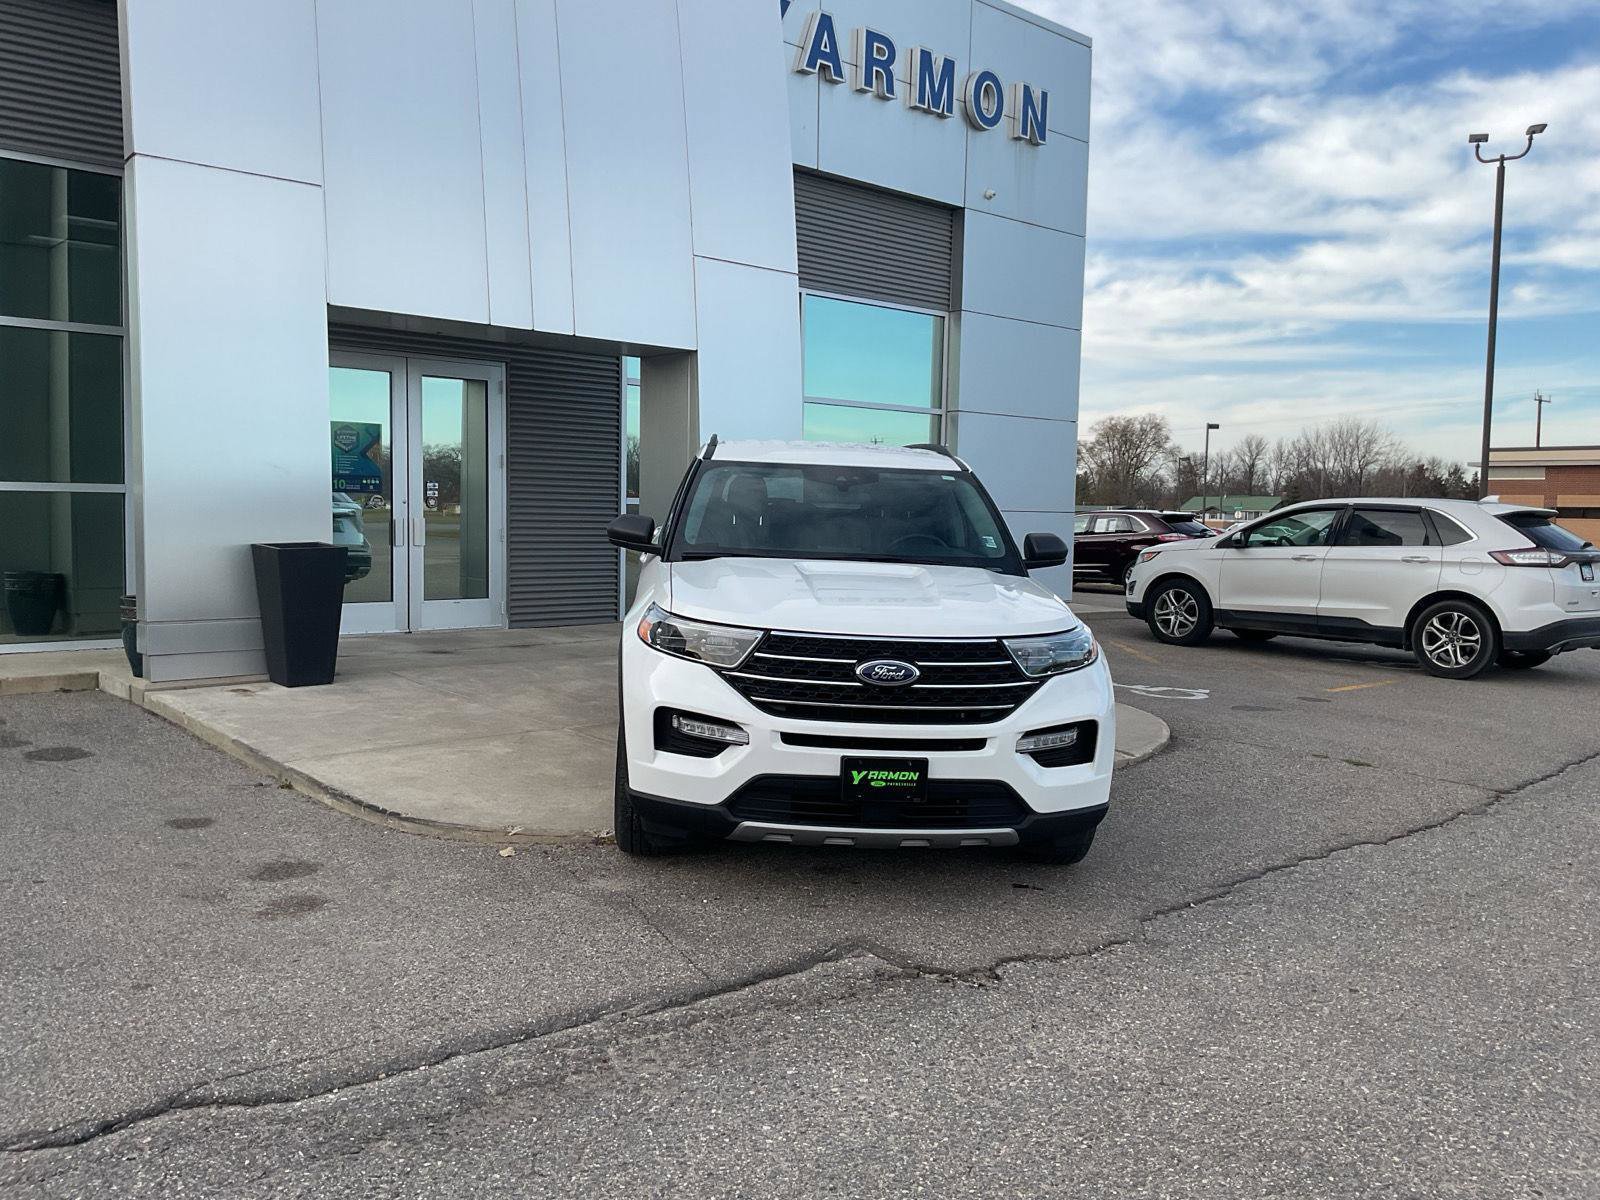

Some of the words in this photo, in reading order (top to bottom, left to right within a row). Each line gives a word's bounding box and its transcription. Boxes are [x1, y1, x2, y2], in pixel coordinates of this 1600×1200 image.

[780, 0, 1049, 146] ARMON
[871, 664, 906, 681] Ford
[851, 770, 920, 785] YARMON
